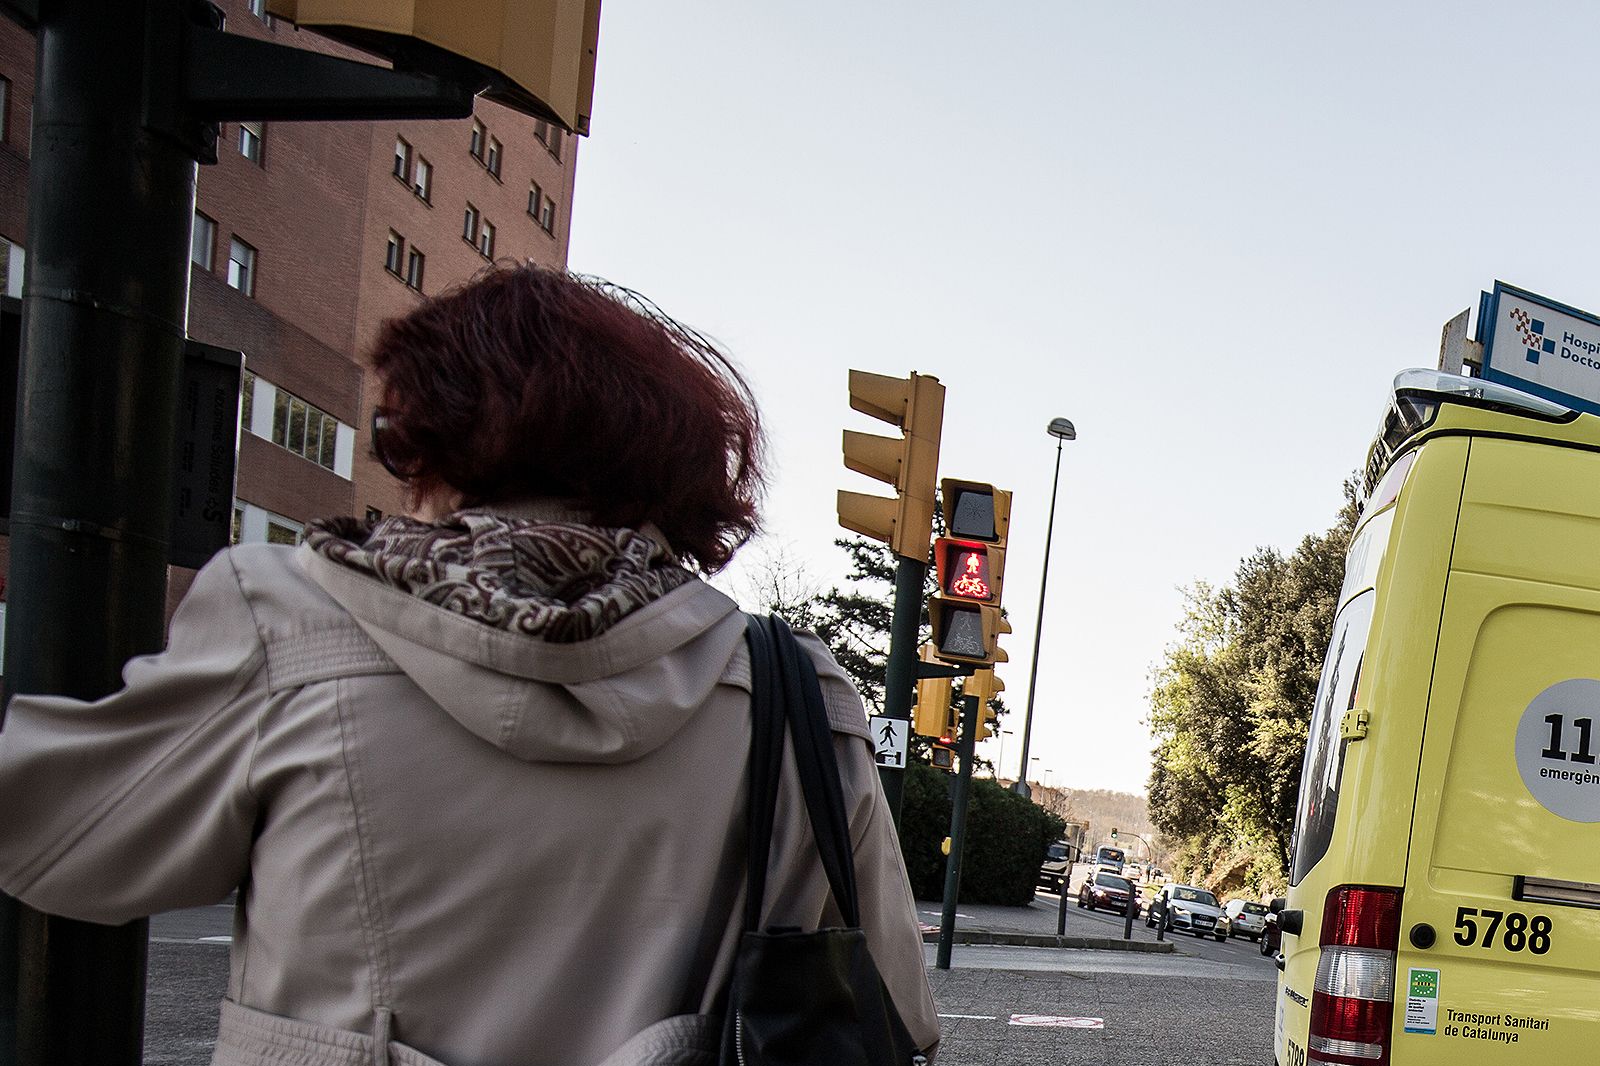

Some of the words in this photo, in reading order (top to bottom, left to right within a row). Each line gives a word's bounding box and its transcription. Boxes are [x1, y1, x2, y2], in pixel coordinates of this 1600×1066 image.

[1453, 906, 1553, 955] 5788
[1447, 1009, 1501, 1028] Transport
[1504, 1015, 1550, 1031] Sanitari
[1444, 1025, 1459, 1037] de
[1462, 1026, 1519, 1044] Catalunya
